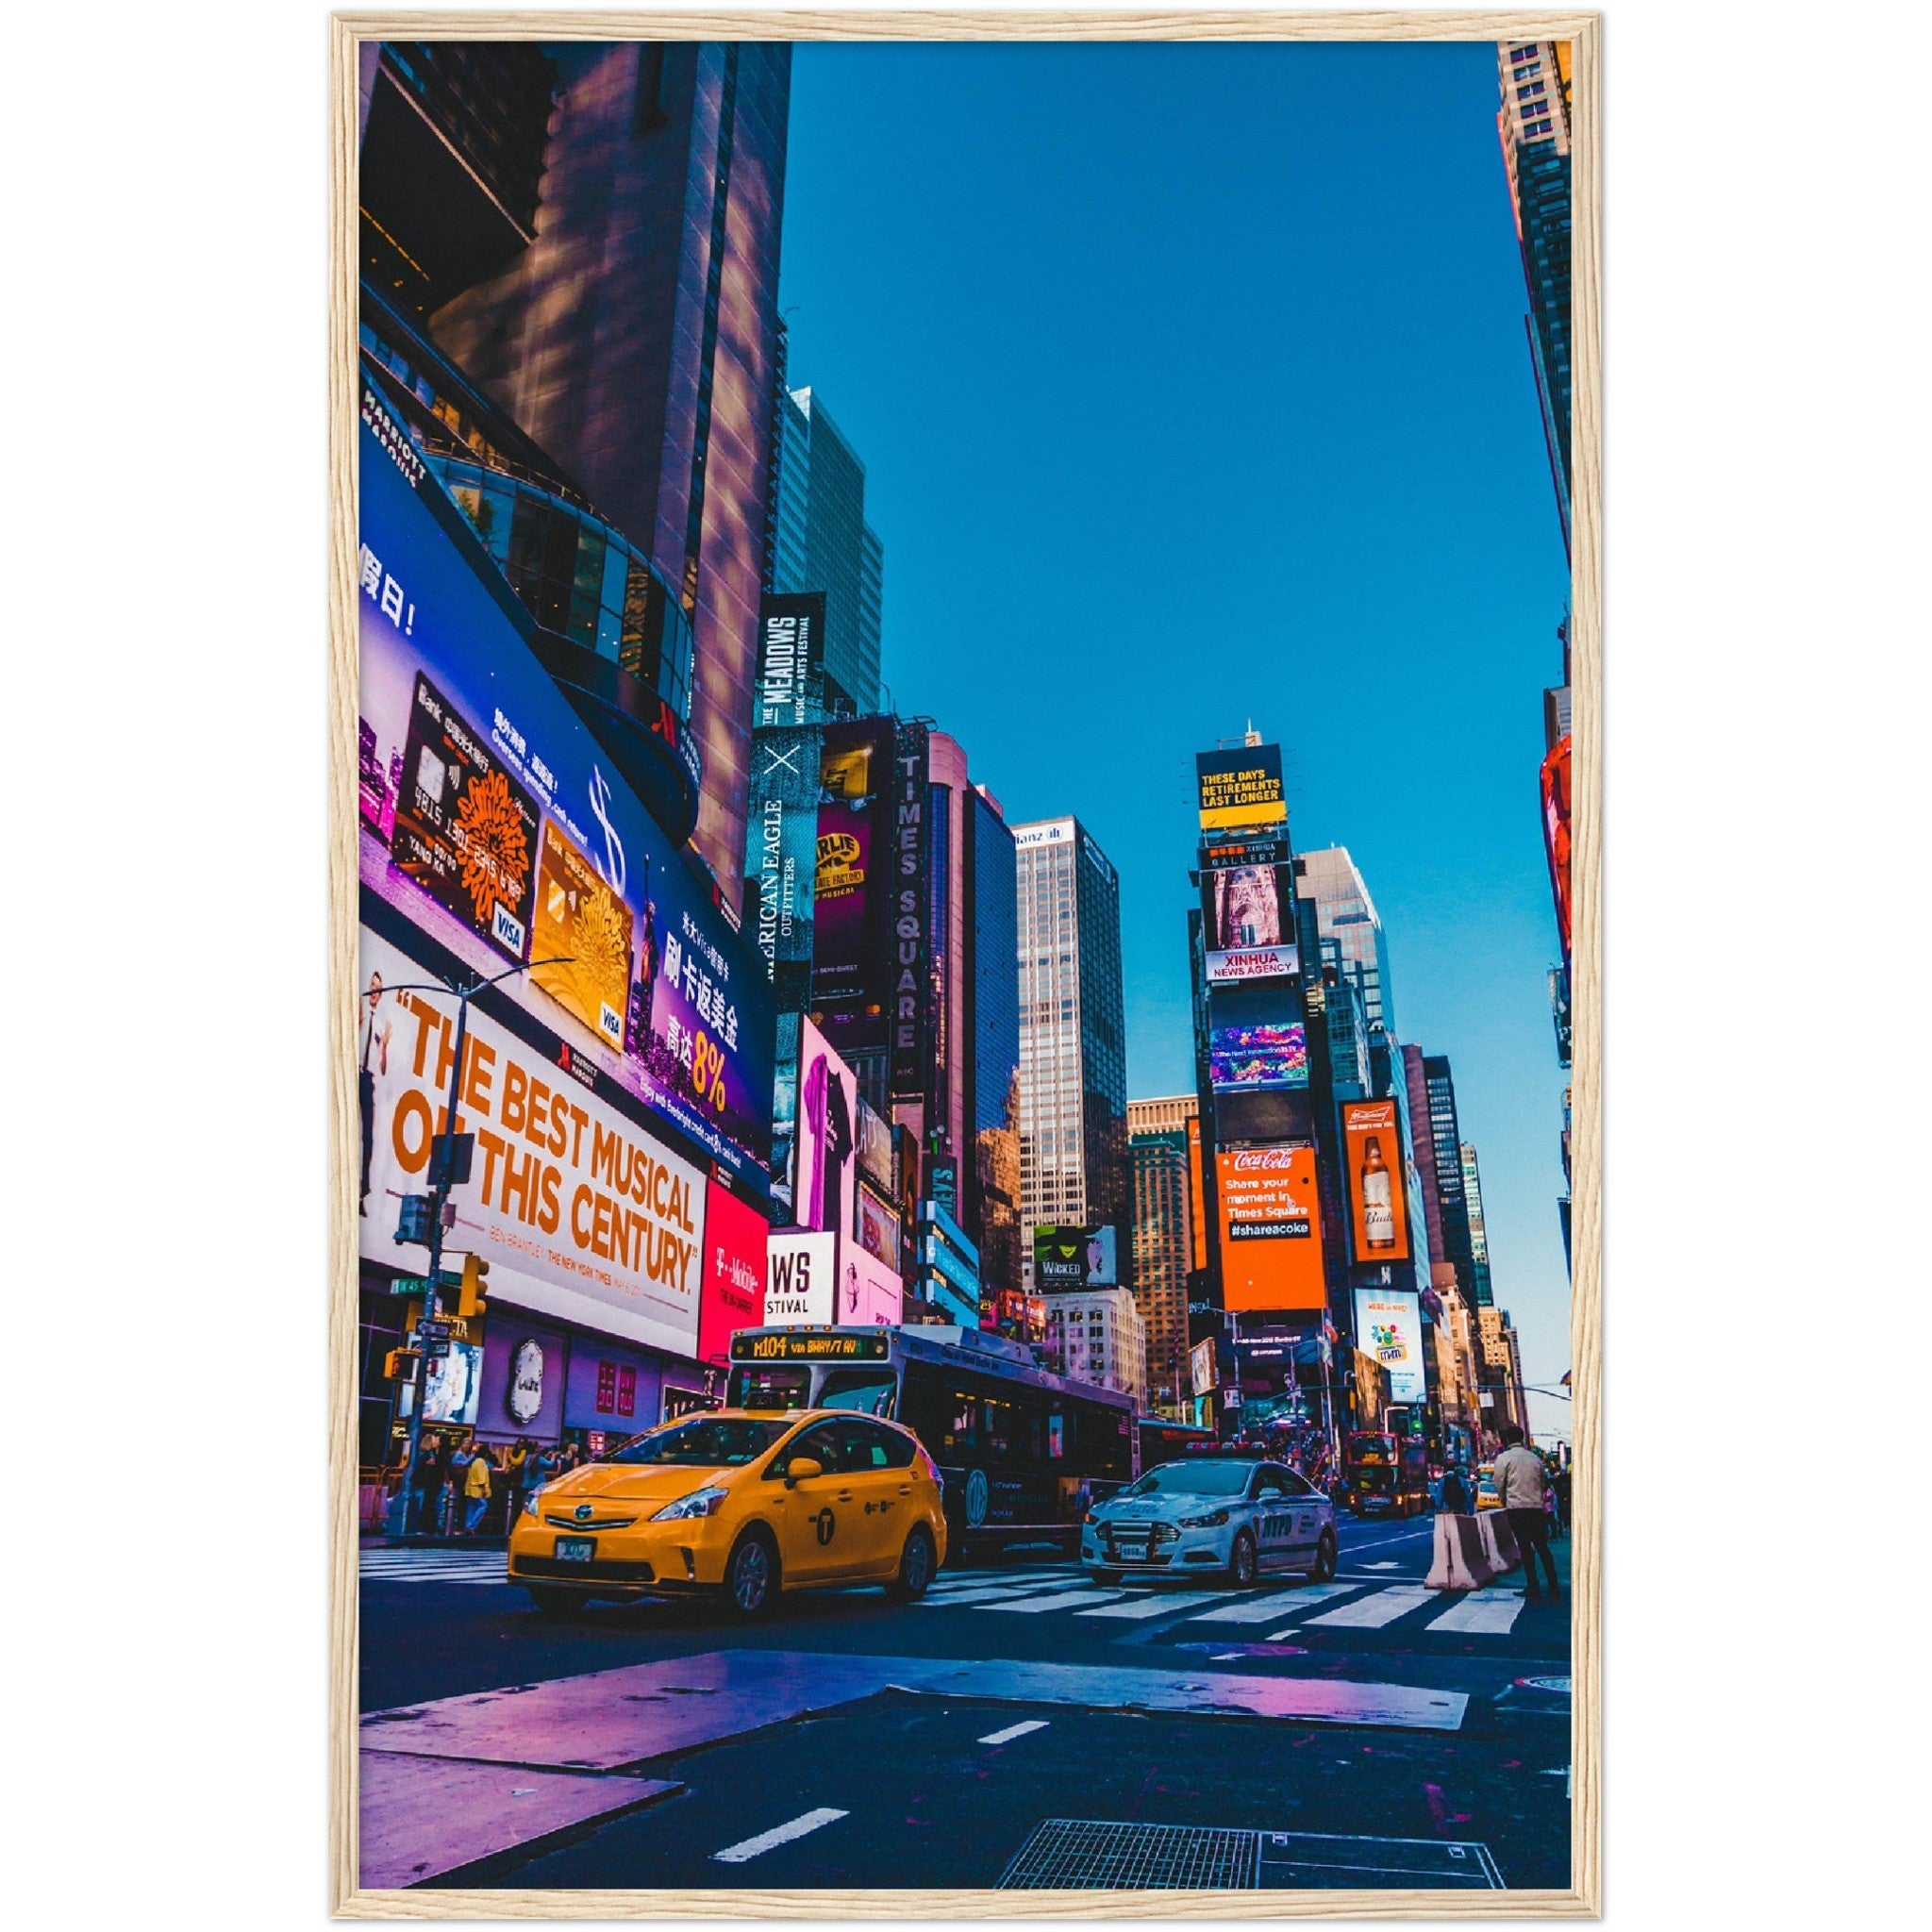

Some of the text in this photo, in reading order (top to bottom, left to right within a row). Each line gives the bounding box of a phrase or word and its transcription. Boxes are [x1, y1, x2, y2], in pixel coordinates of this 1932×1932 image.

[797, 617, 809, 655] FESTIVAL
[763, 617, 796, 725] THE MEADOWS
[797, 658, 808, 679] ARTS
[795, 696, 806, 724] MUSIC
[1202, 769, 1265, 786] THESE DAYS
[1202, 778, 1280, 797] RETIREMENTS
[1203, 790, 1278, 808] LAST LONGER
[763, 800, 782, 871] EAGLE
[817, 835, 855, 859] RLIE
[1212, 853, 1275, 866] GALLERY
[833, 872, 861, 885] FACTORY
[781, 857, 795, 937] OUTFITTERS
[823, 888, 855, 898] MUSICAL
[896, 756, 921, 1048] TIMES SQUARE
[497, 912, 520, 948] VISA
[1214, 963, 1291, 977] NEWS AGENCY
[1225, 953, 1278, 967] XINHUA
[603, 1007, 620, 1037] VISA
[501, 1059, 590, 1169] BEST
[591, 1120, 694, 1235] MUSICAL
[478, 1127, 563, 1236] THIS
[1225, 1178, 1289, 1190] Share your
[1227, 1193, 1275, 1205] moment
[1227, 1206, 1308, 1218] Times Square
[1231, 1223, 1308, 1236] #shareacoke
[548, 1249, 561, 1266] THE
[561, 1255, 576, 1272] NEW
[577, 1262, 593, 1277] YORK
[594, 1269, 611, 1286] TIMES
[765, 1252, 810, 1294] WS
[765, 1299, 808, 1314] STIVAL
[753, 1336, 787, 1357] M104
[807, 1340, 841, 1354] BWAY/7
[843, 1340, 857, 1353] AV
[1262, 1514, 1291, 1538] NYPD
